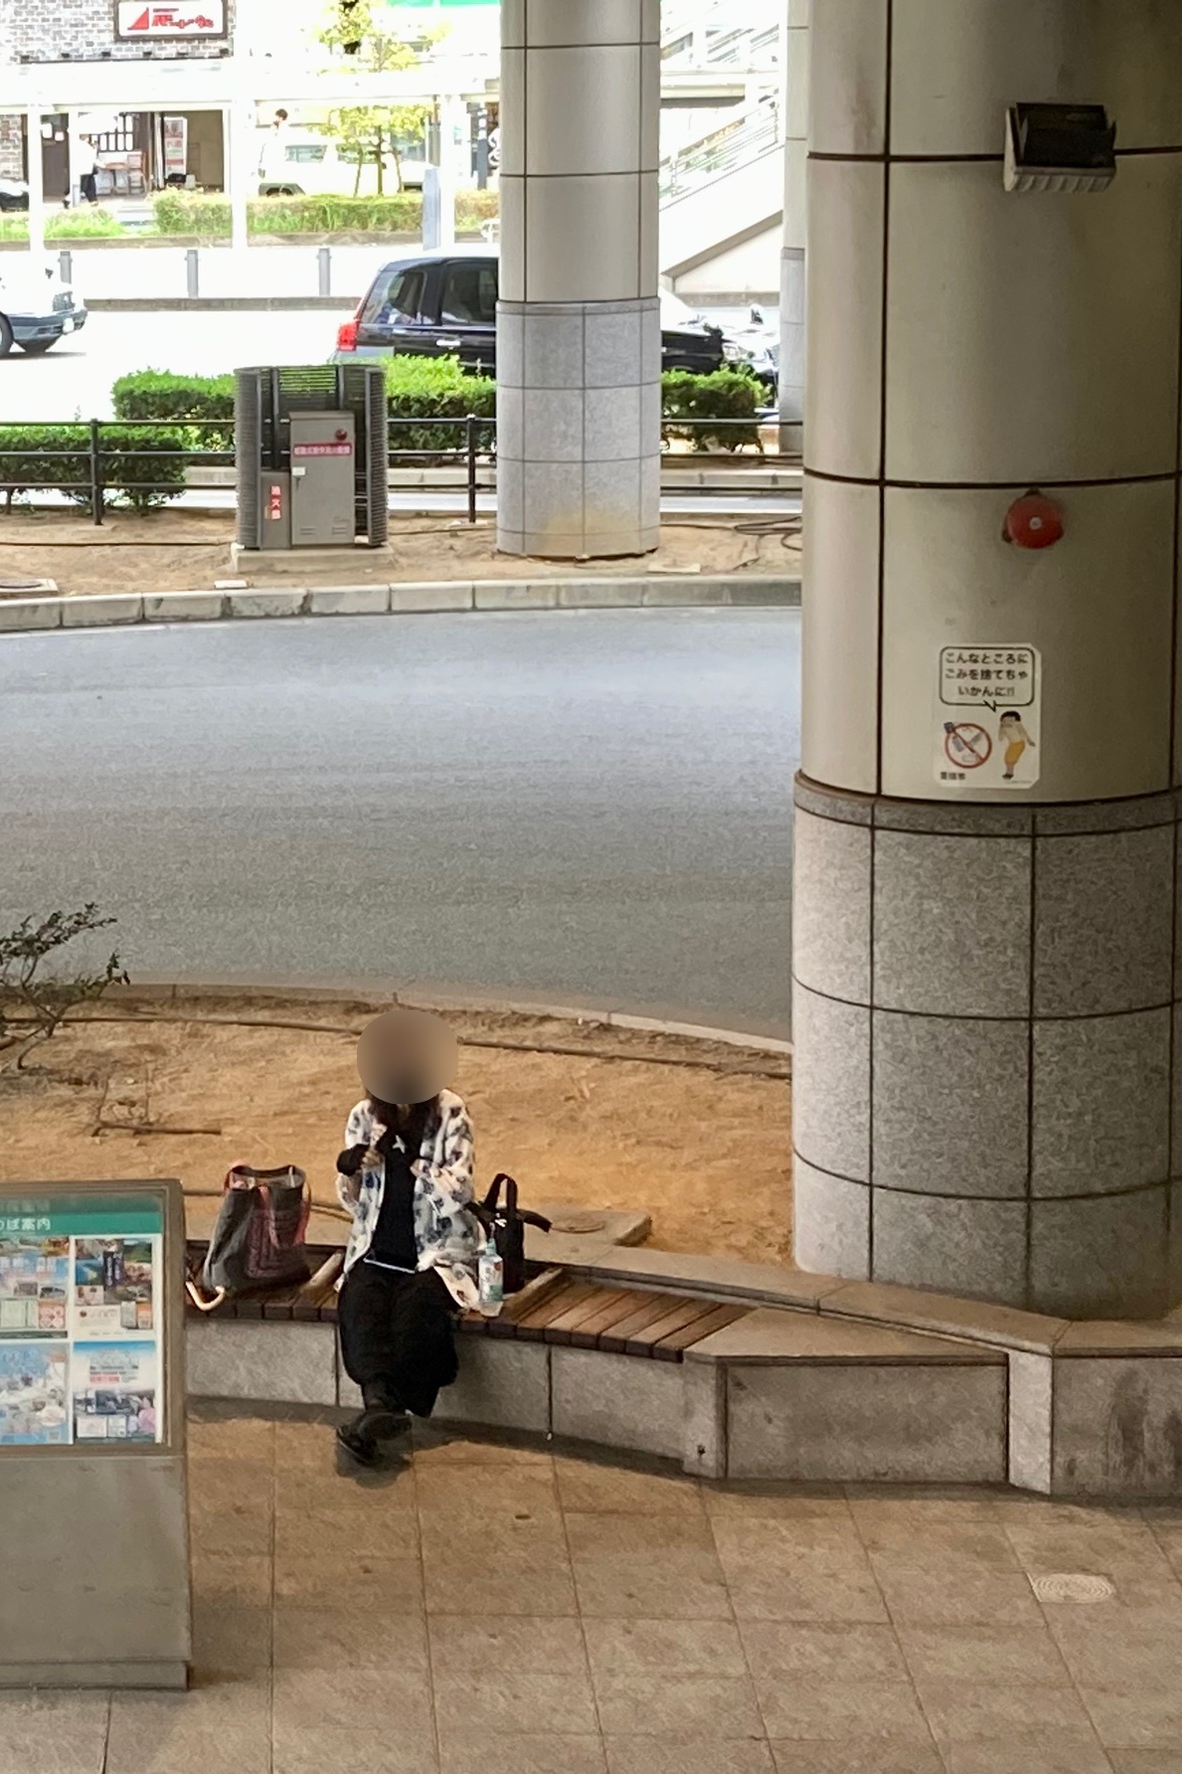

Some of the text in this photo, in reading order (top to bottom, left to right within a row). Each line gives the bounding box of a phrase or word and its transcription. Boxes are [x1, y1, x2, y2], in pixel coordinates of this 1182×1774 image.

[945, 652, 1029, 665] こんなところに
